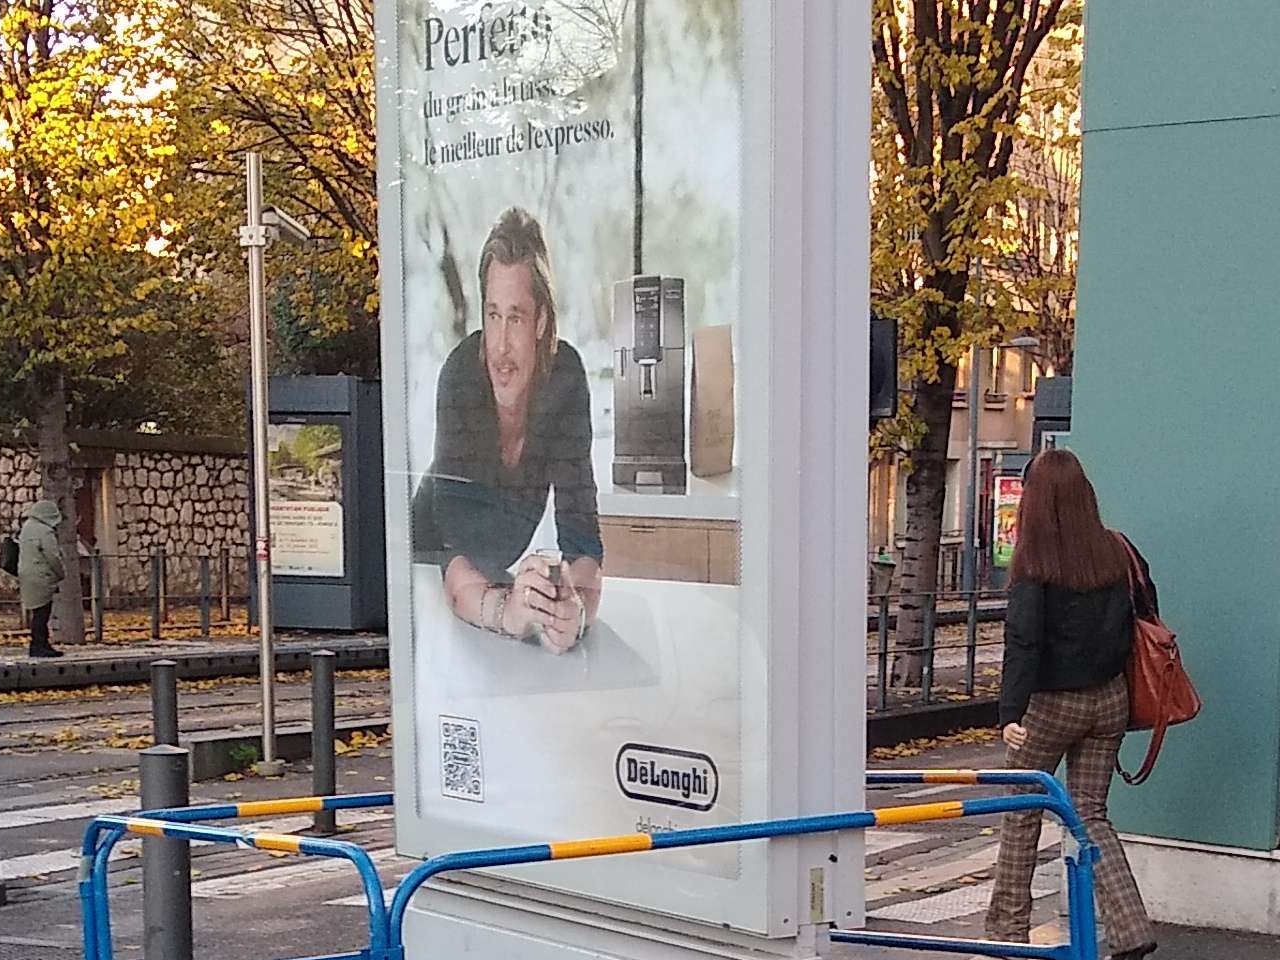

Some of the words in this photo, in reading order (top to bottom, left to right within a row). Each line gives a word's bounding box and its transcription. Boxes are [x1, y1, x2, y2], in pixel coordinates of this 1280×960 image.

[423, 90, 442, 118] du
[424, 138, 436, 166] le
[440, 131, 503, 164] meilleur
[506, 124, 524, 154] de
